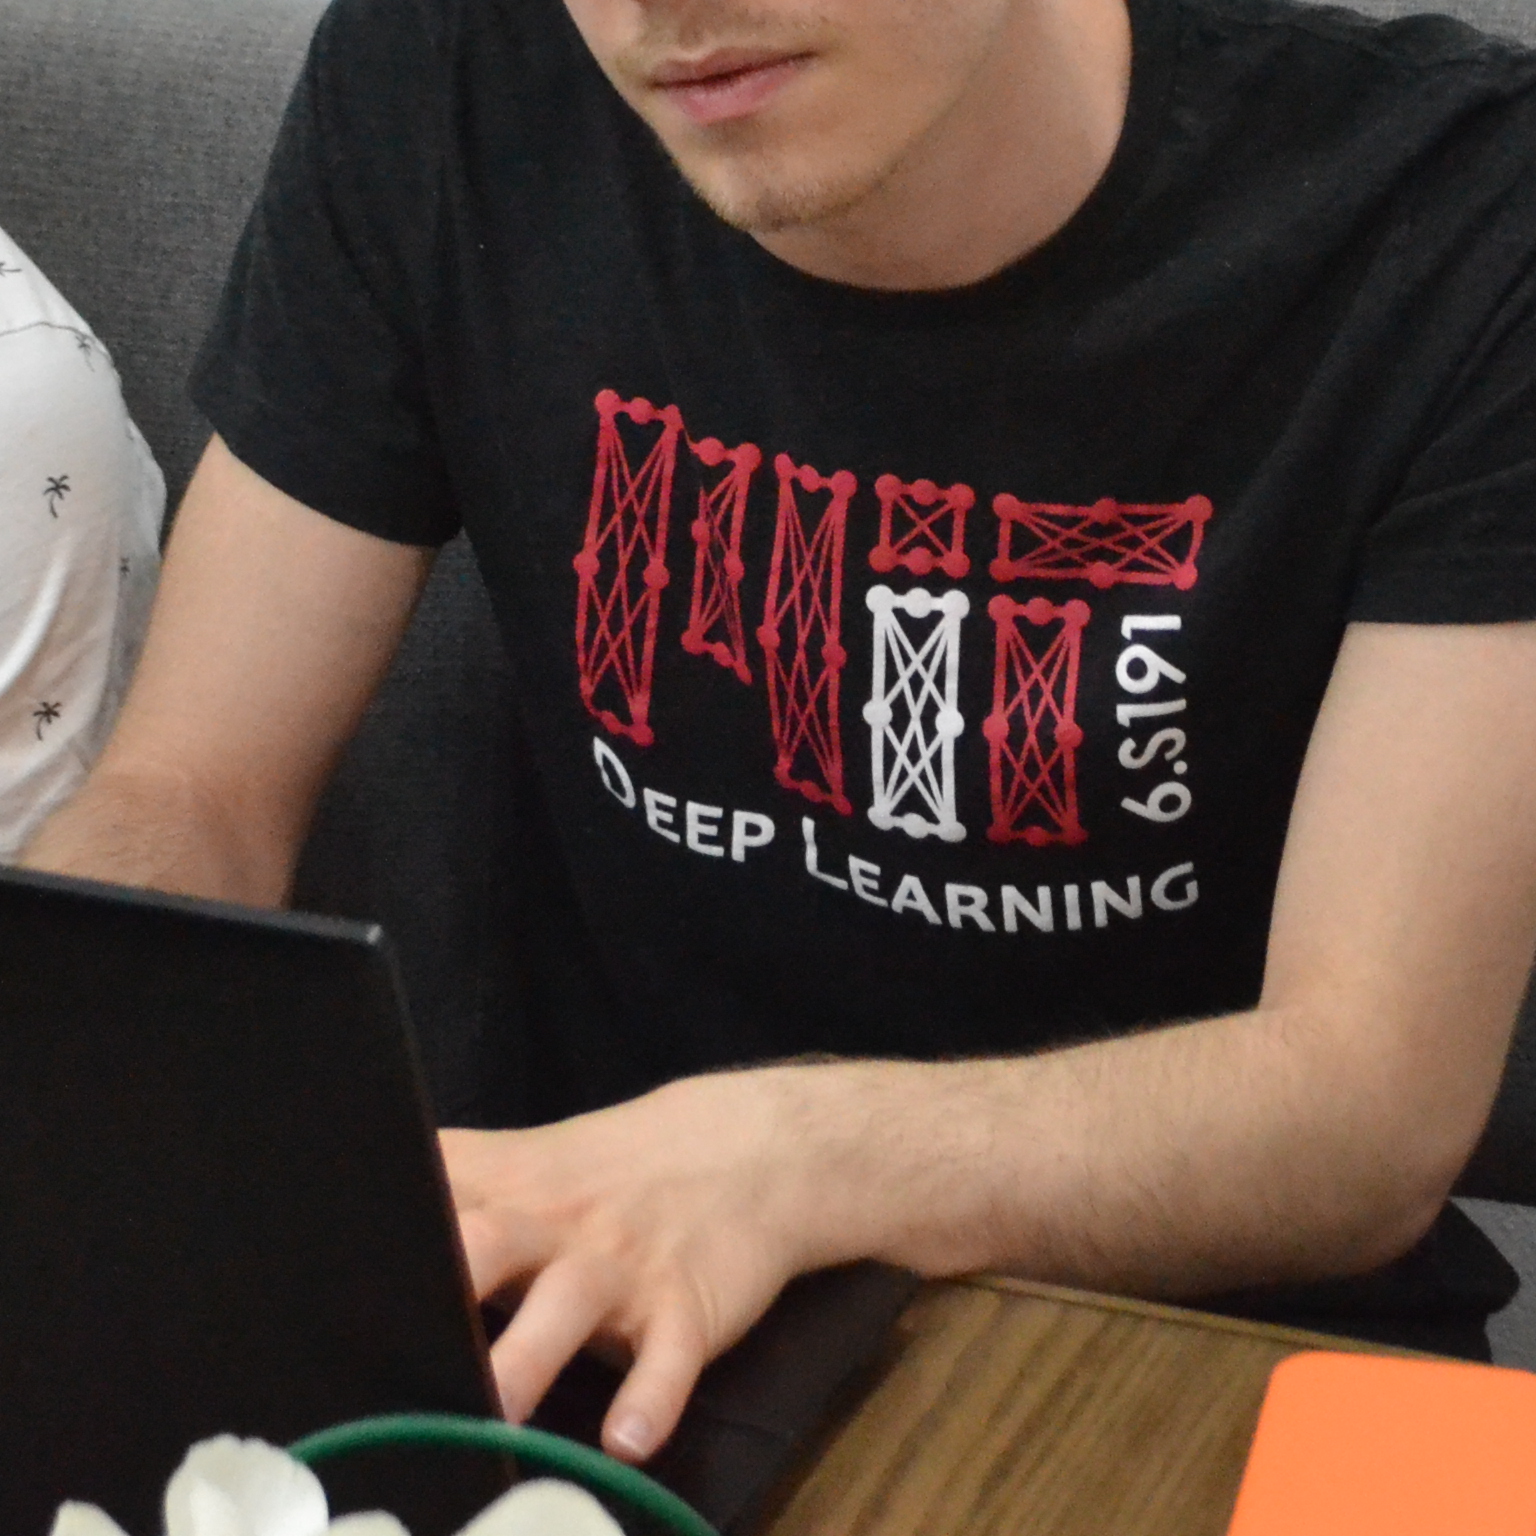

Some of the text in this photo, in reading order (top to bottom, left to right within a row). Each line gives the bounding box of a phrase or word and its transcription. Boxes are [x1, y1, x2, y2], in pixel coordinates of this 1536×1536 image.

[1115, 613, 1194, 824] 6.S191
[591, 735, 1201, 934] DEEP LEARNING
